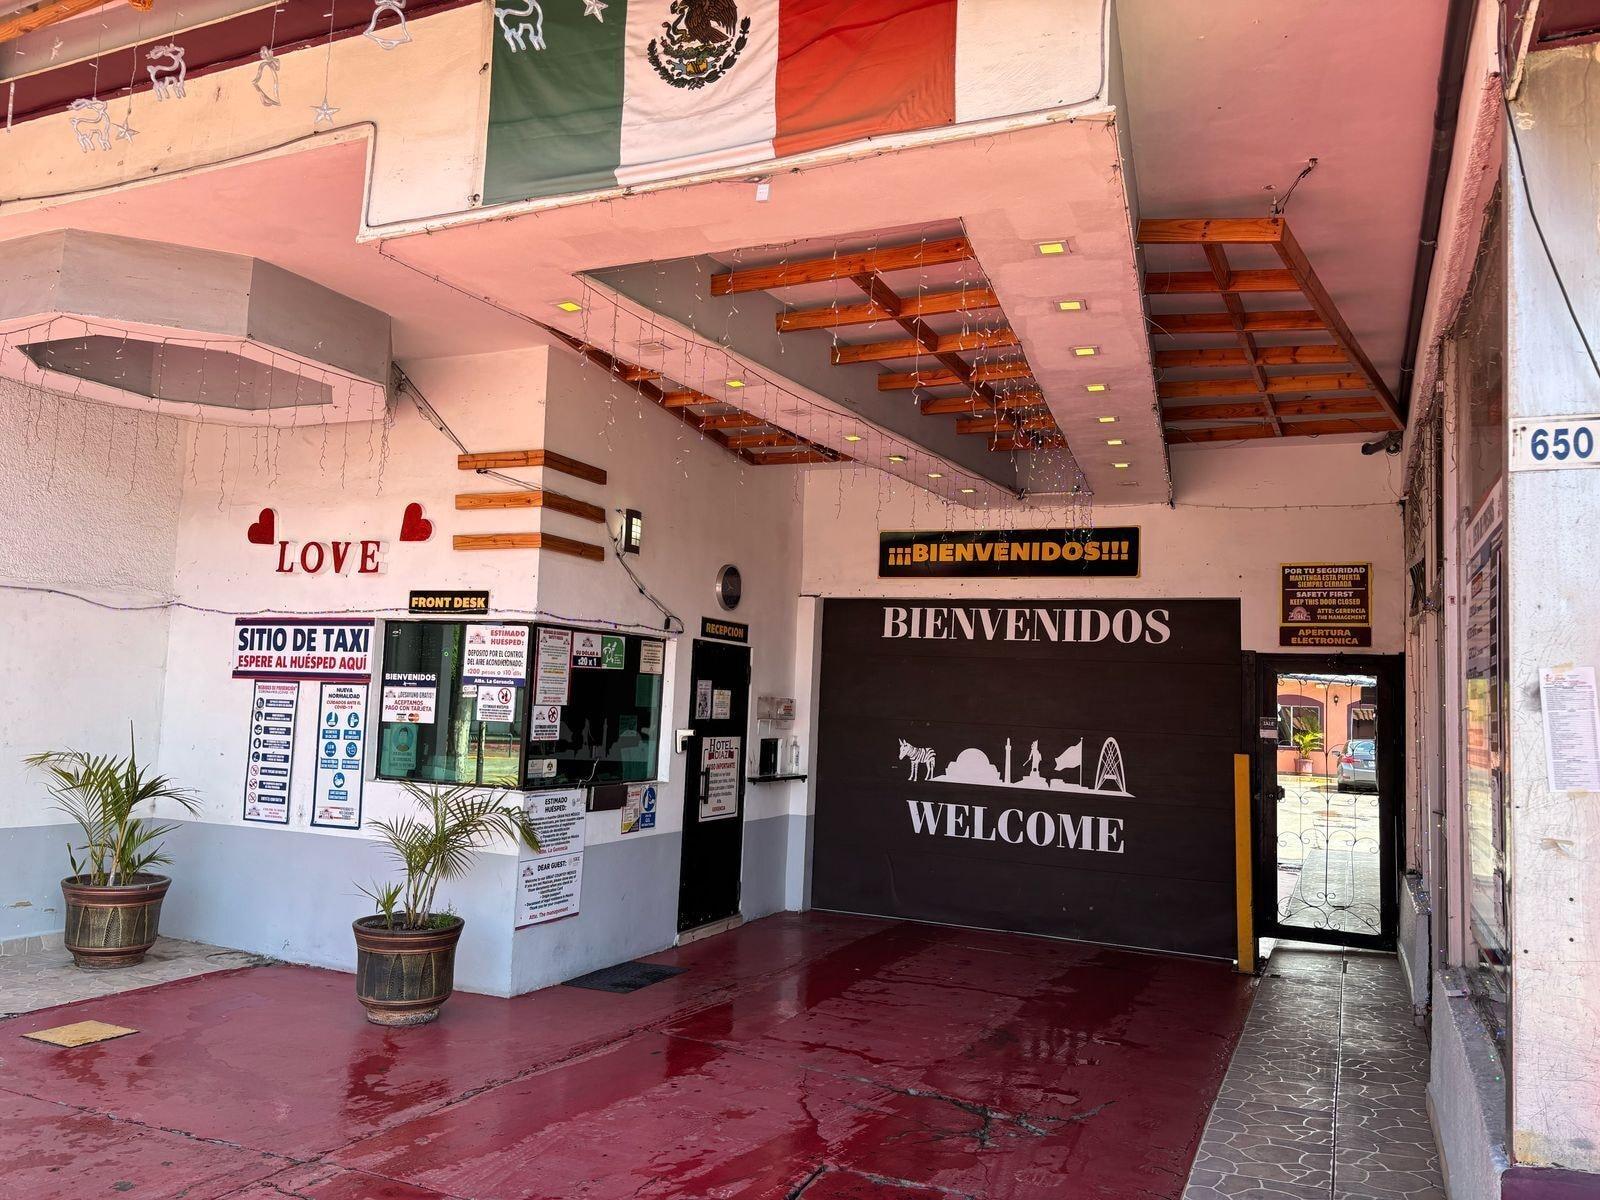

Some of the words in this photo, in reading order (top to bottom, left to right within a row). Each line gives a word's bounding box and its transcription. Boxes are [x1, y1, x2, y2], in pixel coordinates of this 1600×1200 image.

[1531, 427, 1593, 460] 650
[276, 541, 380, 574] LOVE
[889, 541, 1129, 566] ¡¡¡BIENVENIDOS!!!
[411, 597, 451, 608] FRONT
[454, 597, 485, 608] DESK
[882, 607, 1170, 644] BIENVENIDOS
[238, 628, 287, 651] SITIO
[292, 629, 317, 651] DE
[323, 629, 369, 652] TAXI
[238, 655, 273, 667] ESPERE
[275, 656, 287, 668] AL
[290, 654, 336, 669] HUÉSPED
[339, 655, 367, 670] AQUÍ
[504, 650, 524, 658] CONTROL
[385, 673, 436, 681] BIENVENIDOS
[710, 739, 733, 752] HOTEL
[545, 796, 568, 805] ESTIMADO
[906, 800, 1124, 853] WELCOME
[537, 863, 550, 871] DEAR
[551, 860, 567, 869] GUEST:
